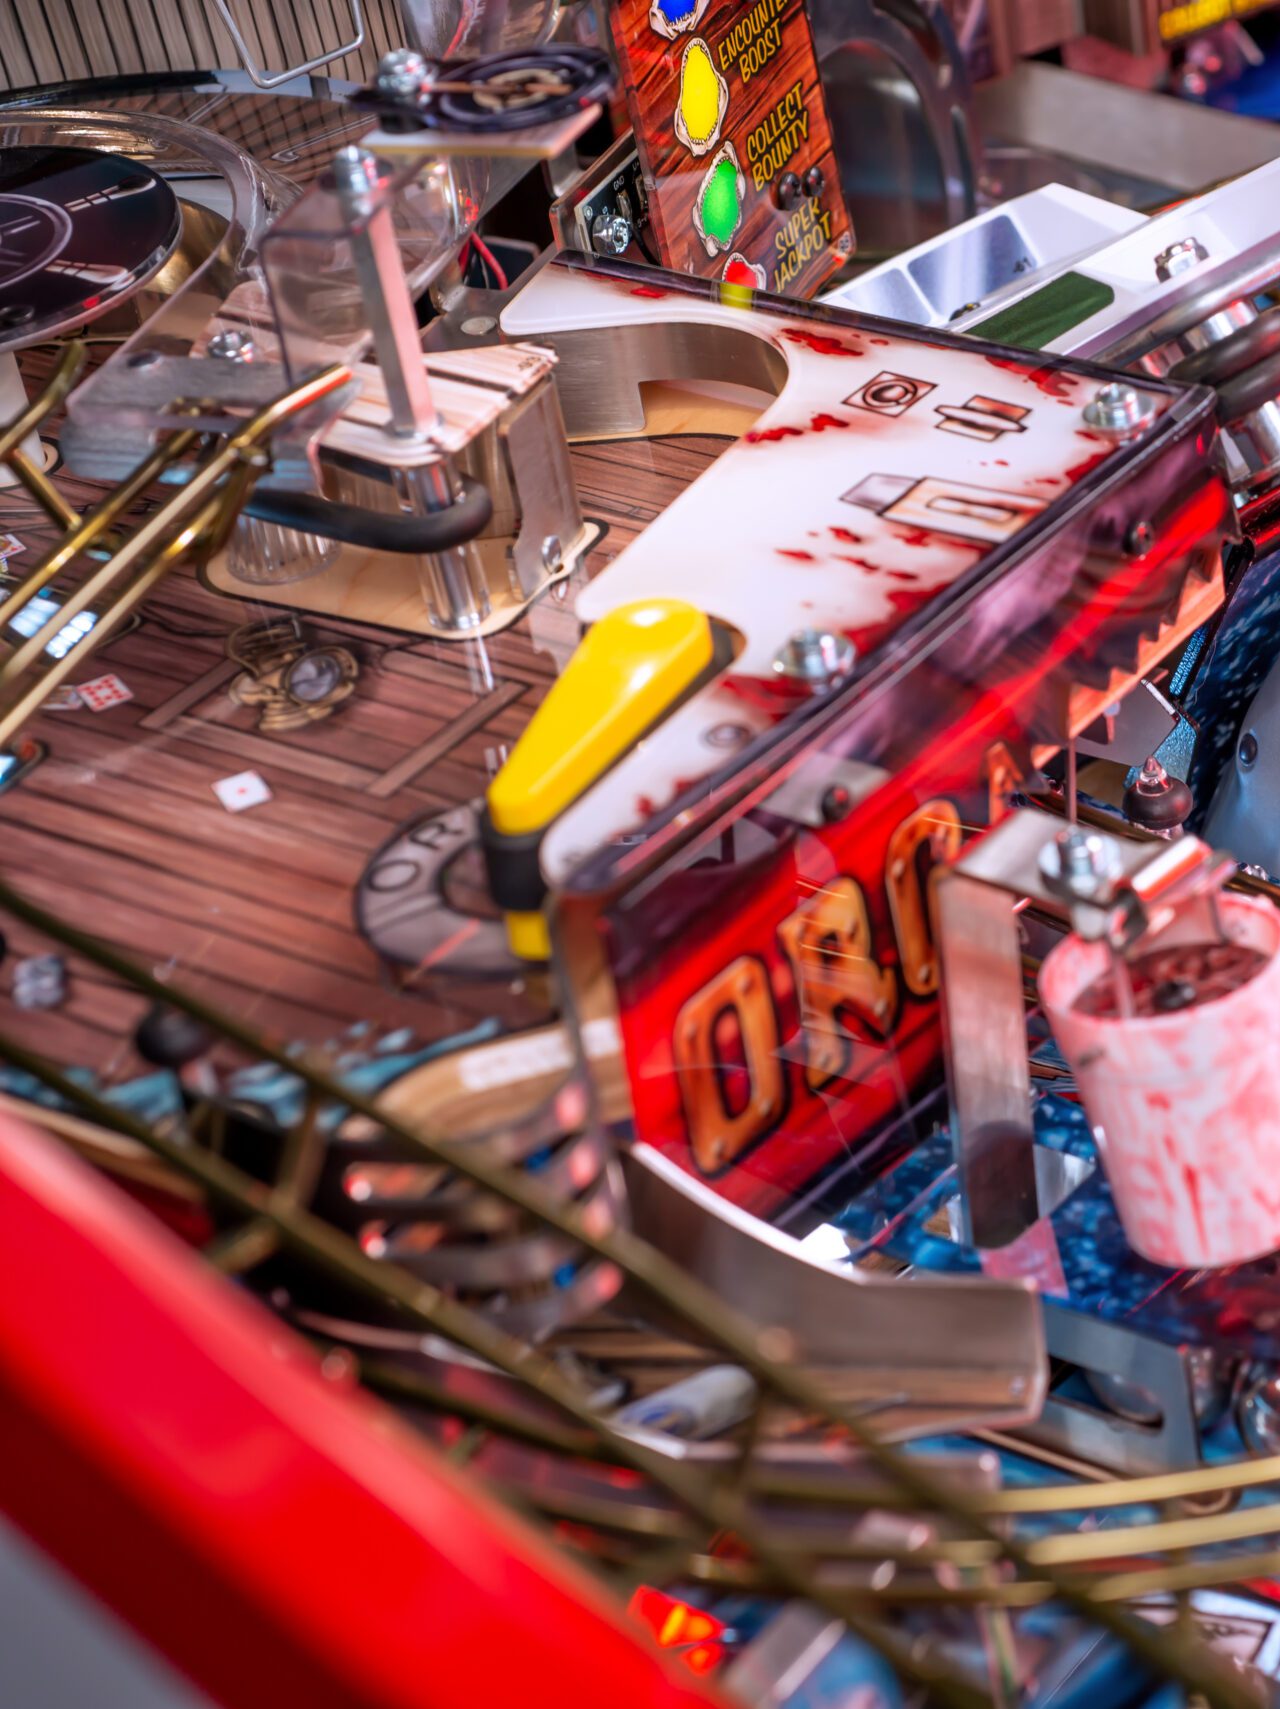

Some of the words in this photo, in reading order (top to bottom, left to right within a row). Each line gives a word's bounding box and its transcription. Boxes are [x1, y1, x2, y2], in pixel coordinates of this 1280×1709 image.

[717, 0, 789, 70] ENCOUNTE
[738, 18, 782, 84] BOOST
[746, 81, 804, 162] COLLECT
[751, 111, 809, 192] BOUNTY
[773, 210, 832, 294] JACKPOT
[774, 196, 821, 260] SUPER
